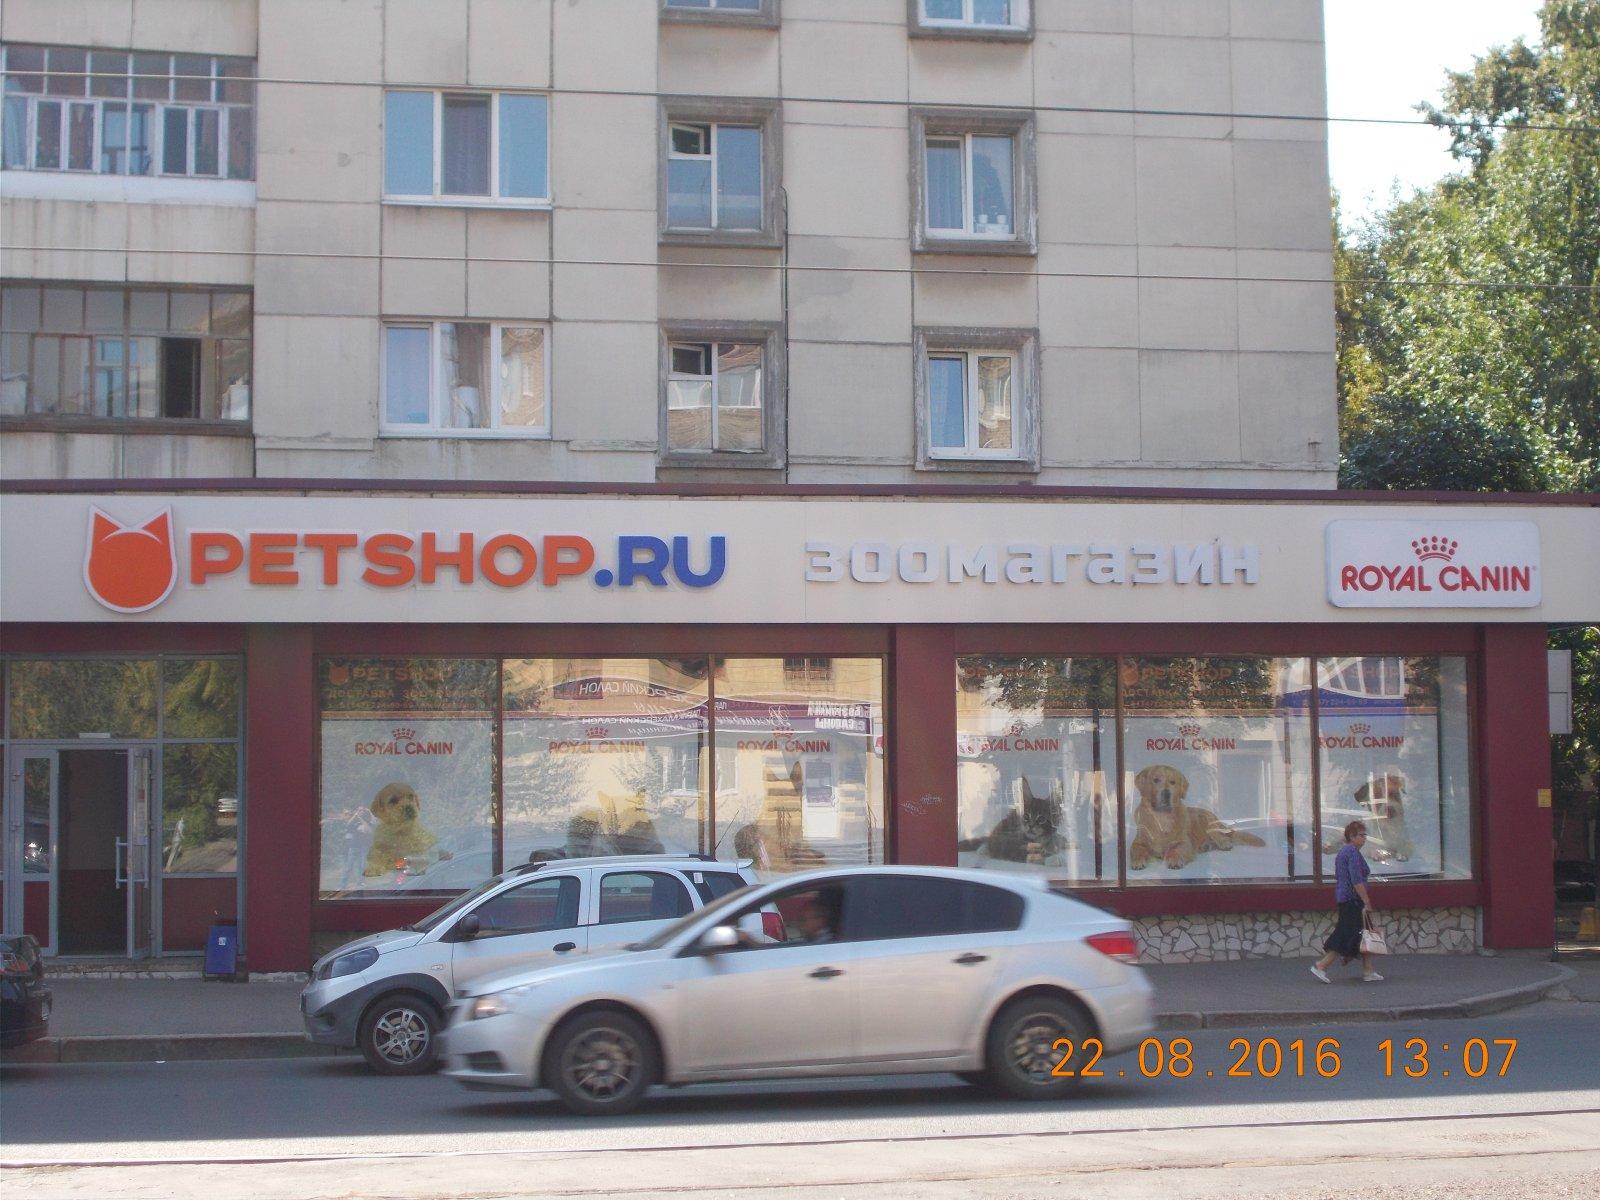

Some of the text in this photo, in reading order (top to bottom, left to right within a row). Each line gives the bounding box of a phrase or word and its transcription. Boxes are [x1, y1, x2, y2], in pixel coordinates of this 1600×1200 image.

[190, 532, 726, 588] PETSHOP.RU
[804, 541, 1260, 584] зоомагазин
[1341, 564, 1531, 592] ROYAL CANIN
[355, 741, 453, 755] ROYAL CANIN
[737, 740, 831, 753] ROYAL CANIN
[1014, 738, 1060, 752] CANIN
[1146, 738, 1188, 751] ROYAL
[1362, 736, 1404, 749] CANIN
